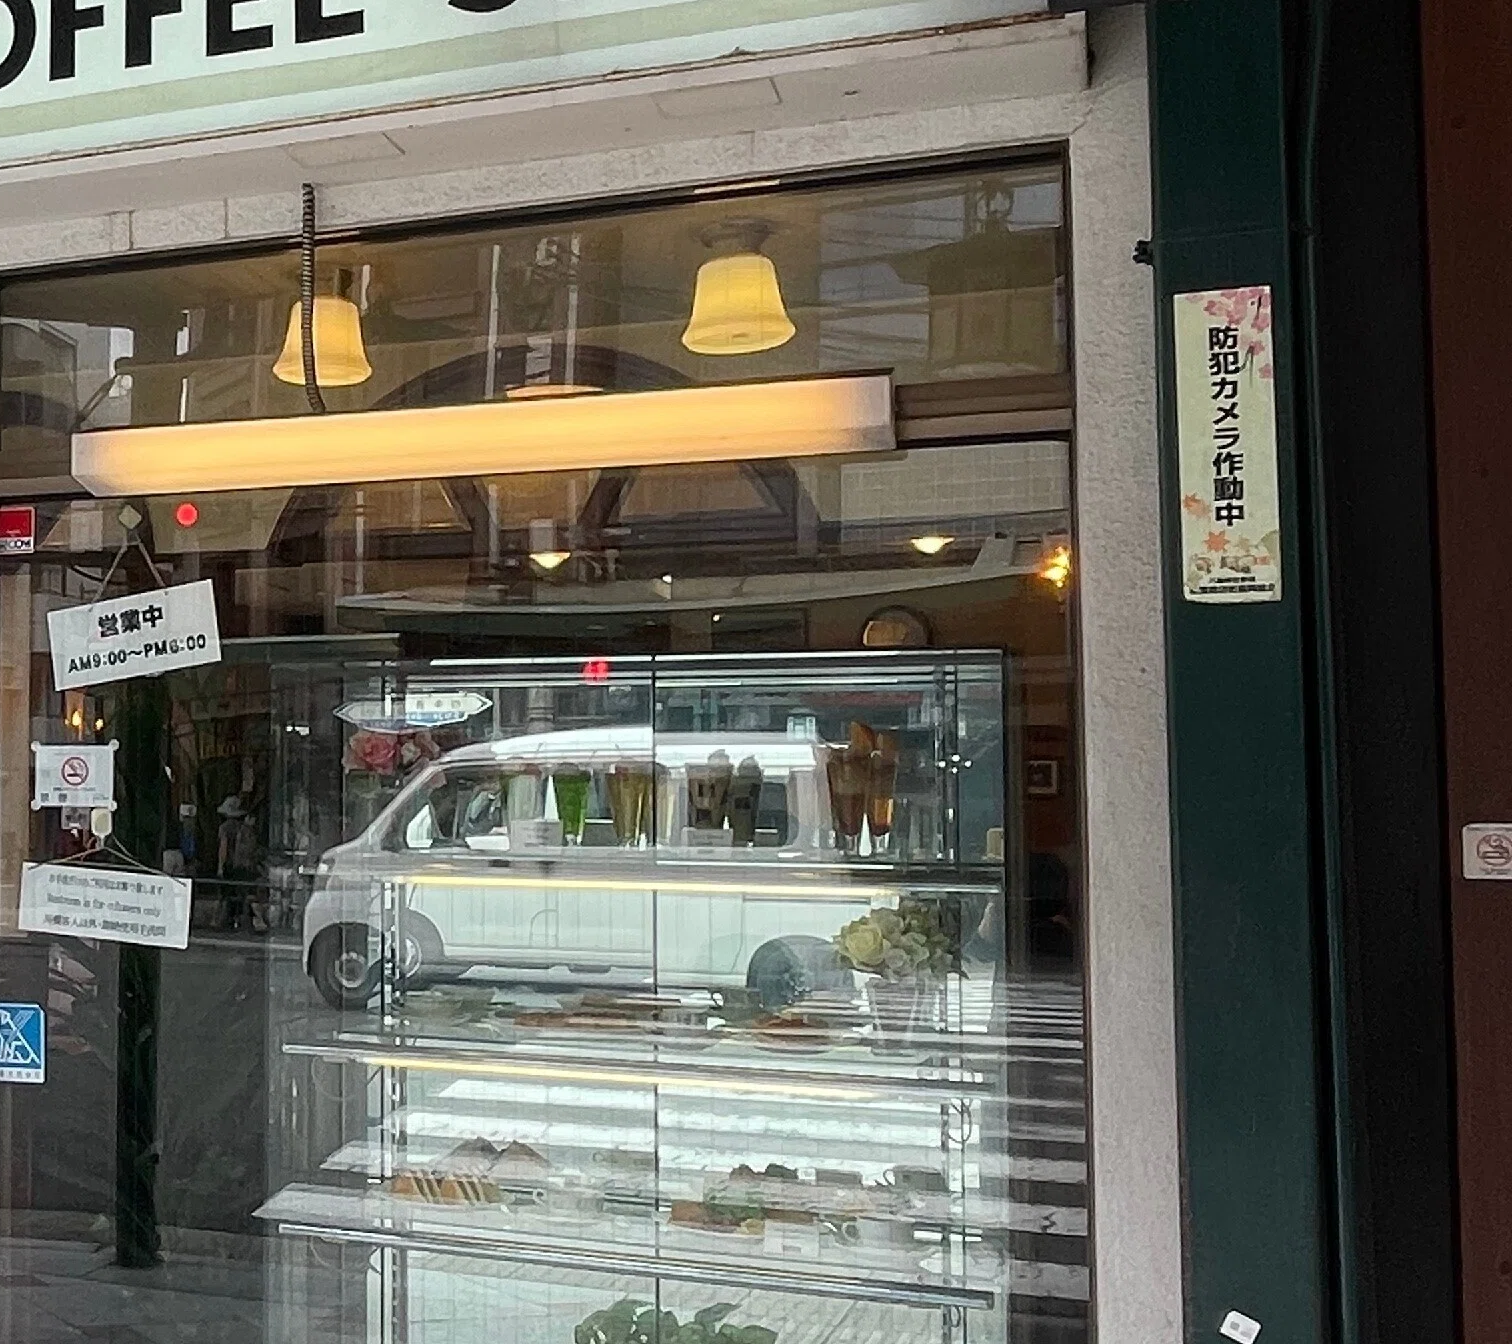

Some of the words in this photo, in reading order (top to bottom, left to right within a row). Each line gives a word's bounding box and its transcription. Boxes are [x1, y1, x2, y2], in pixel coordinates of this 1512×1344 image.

[1208, 326, 1245, 527] 防犯カメラ作動中
[97, 604, 164, 639] 営業中
